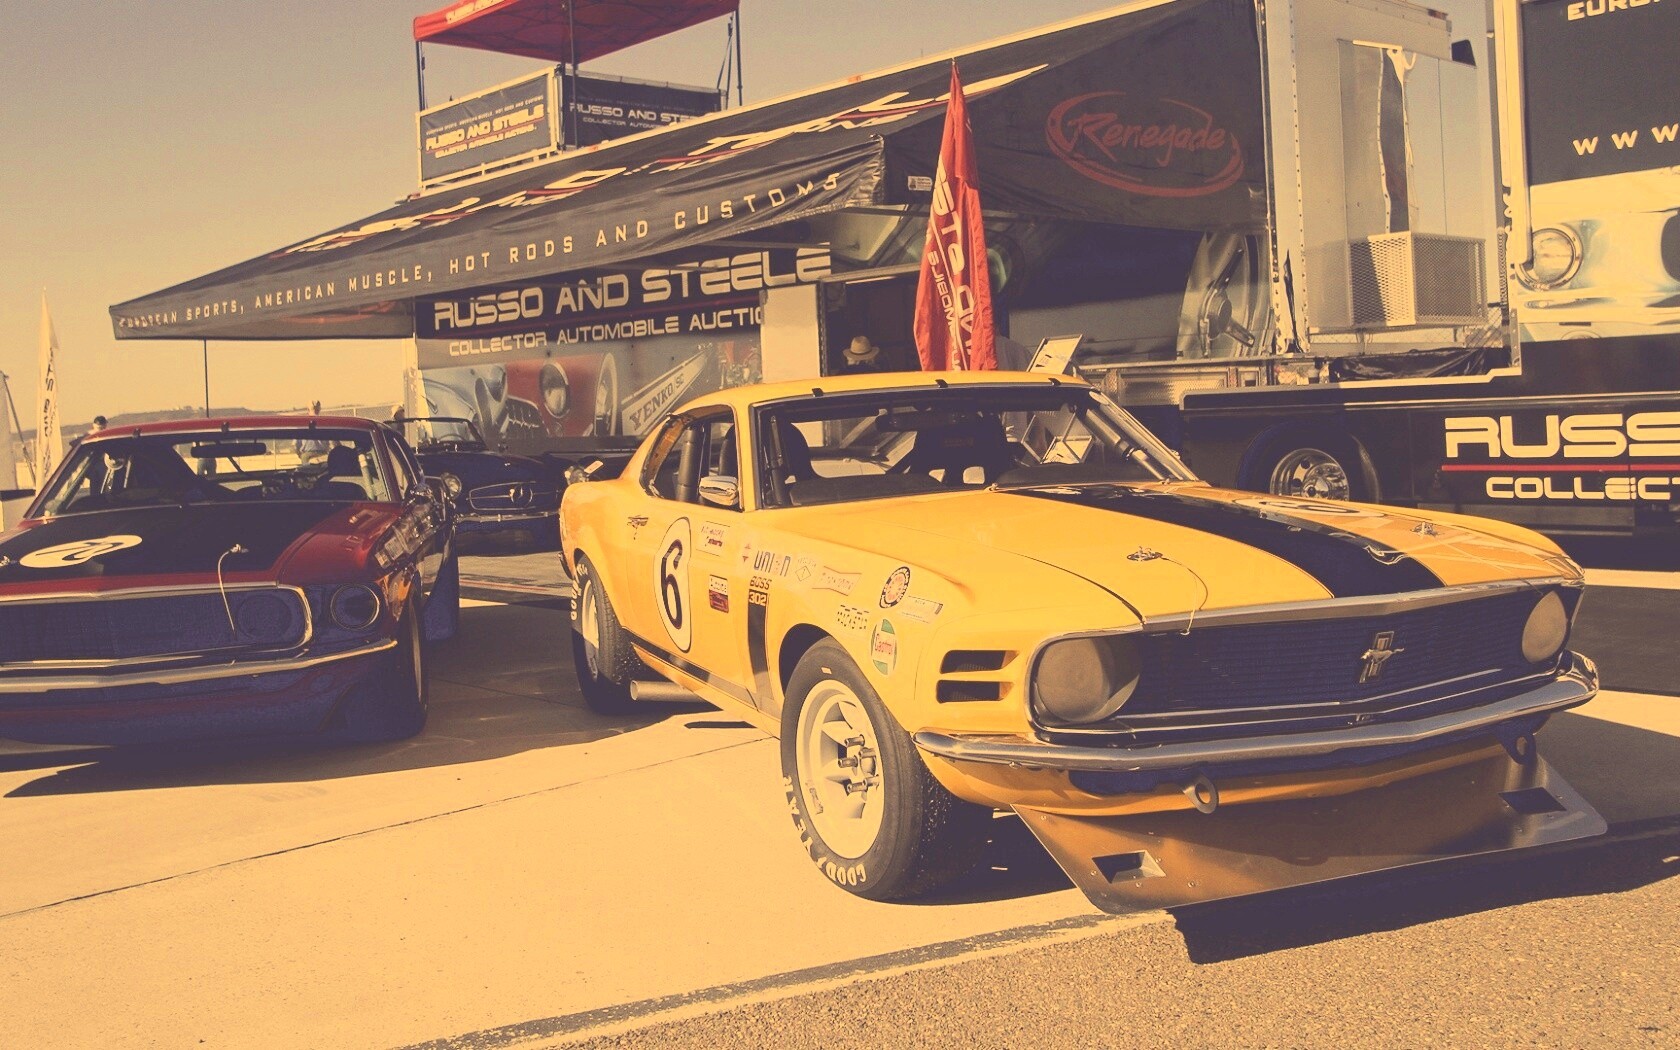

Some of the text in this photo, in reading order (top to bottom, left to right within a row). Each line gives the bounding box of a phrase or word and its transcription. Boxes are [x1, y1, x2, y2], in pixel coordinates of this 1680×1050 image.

[627, 109, 657, 121] AND
[1066, 112, 1227, 167] Renegade
[186, 299, 244, 321] SPORTS,
[255, 282, 335, 309] AMERICAN
[348, 264, 433, 293] MUSCLE,
[449, 251, 491, 275] HOT
[509, 235, 573, 264] RODS
[596, 220, 649, 247] AND
[674, 172, 841, 230] CUSTOMS
[434, 242, 832, 331] RUSSO AND STEELE
[449, 331, 548, 357] COLLECTOR
[556, 316, 680, 346] AUTOMOBILE
[629, 382, 674, 431] YENKO
[1445, 411, 1680, 458] RUSS
[1486, 476, 1680, 500] COLLEC
[660, 539, 683, 629] 6
[748, 591, 768, 606] 302
[750, 575, 772, 590] BOSS
